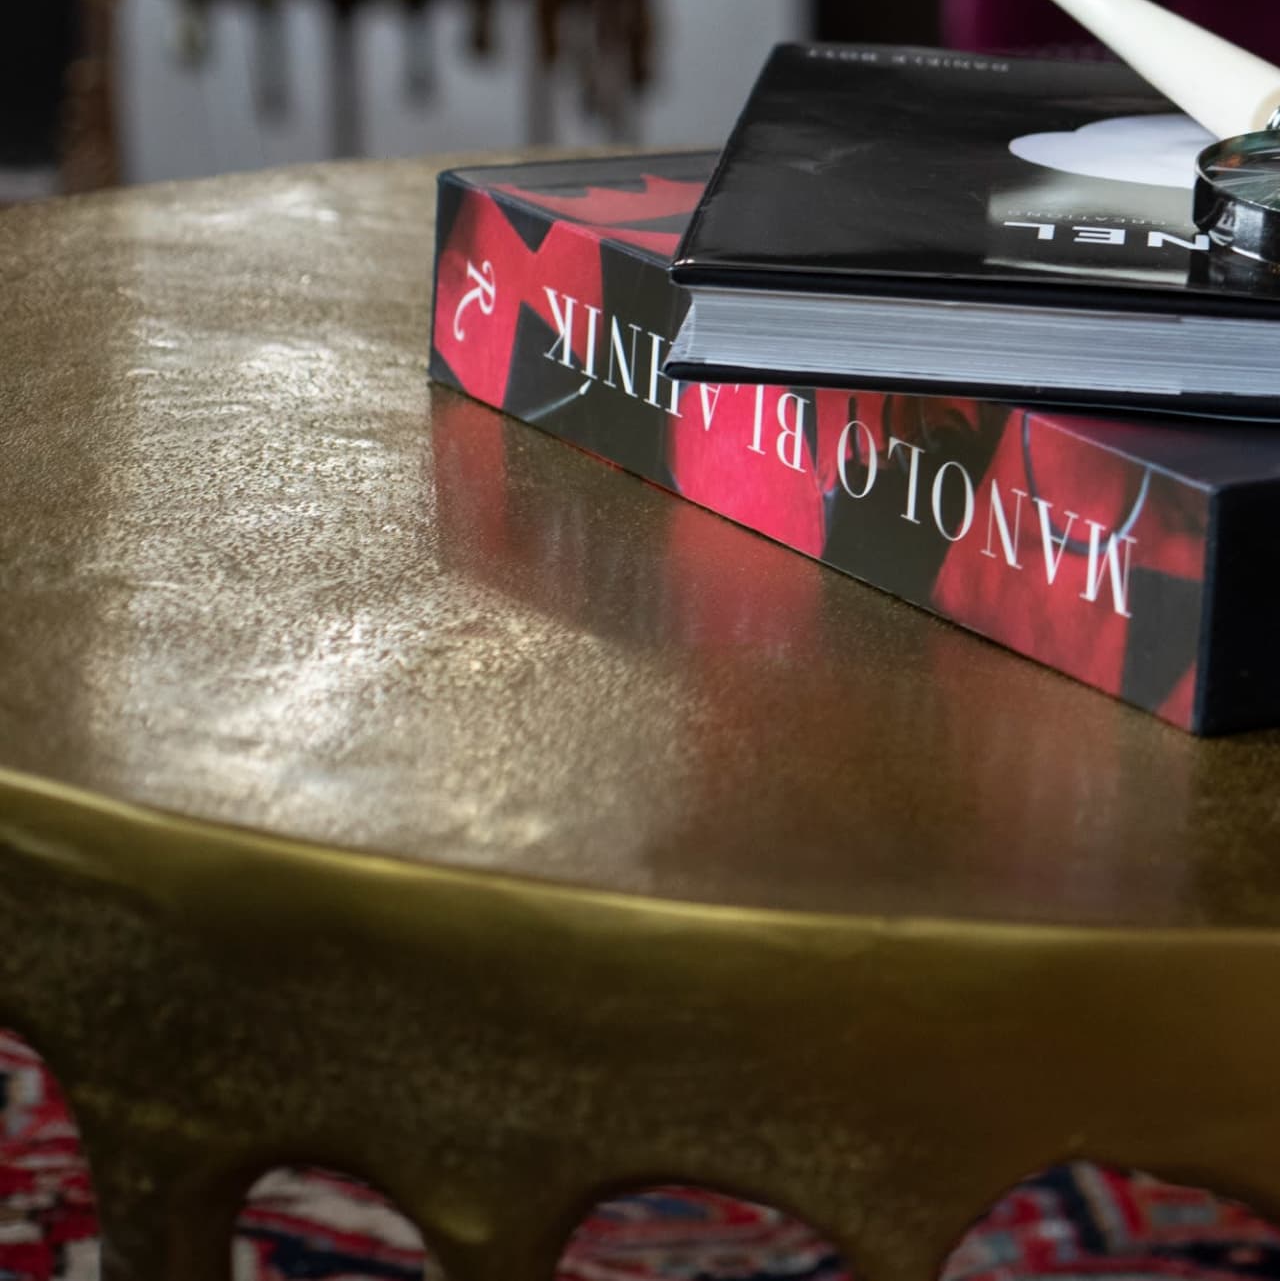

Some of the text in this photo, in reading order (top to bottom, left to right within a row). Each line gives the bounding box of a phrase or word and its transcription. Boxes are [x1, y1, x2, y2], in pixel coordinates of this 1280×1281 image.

[1003, 221, 1210, 251] NEL
[541, 283, 1138, 618] MANOLO BLAHNÍK
